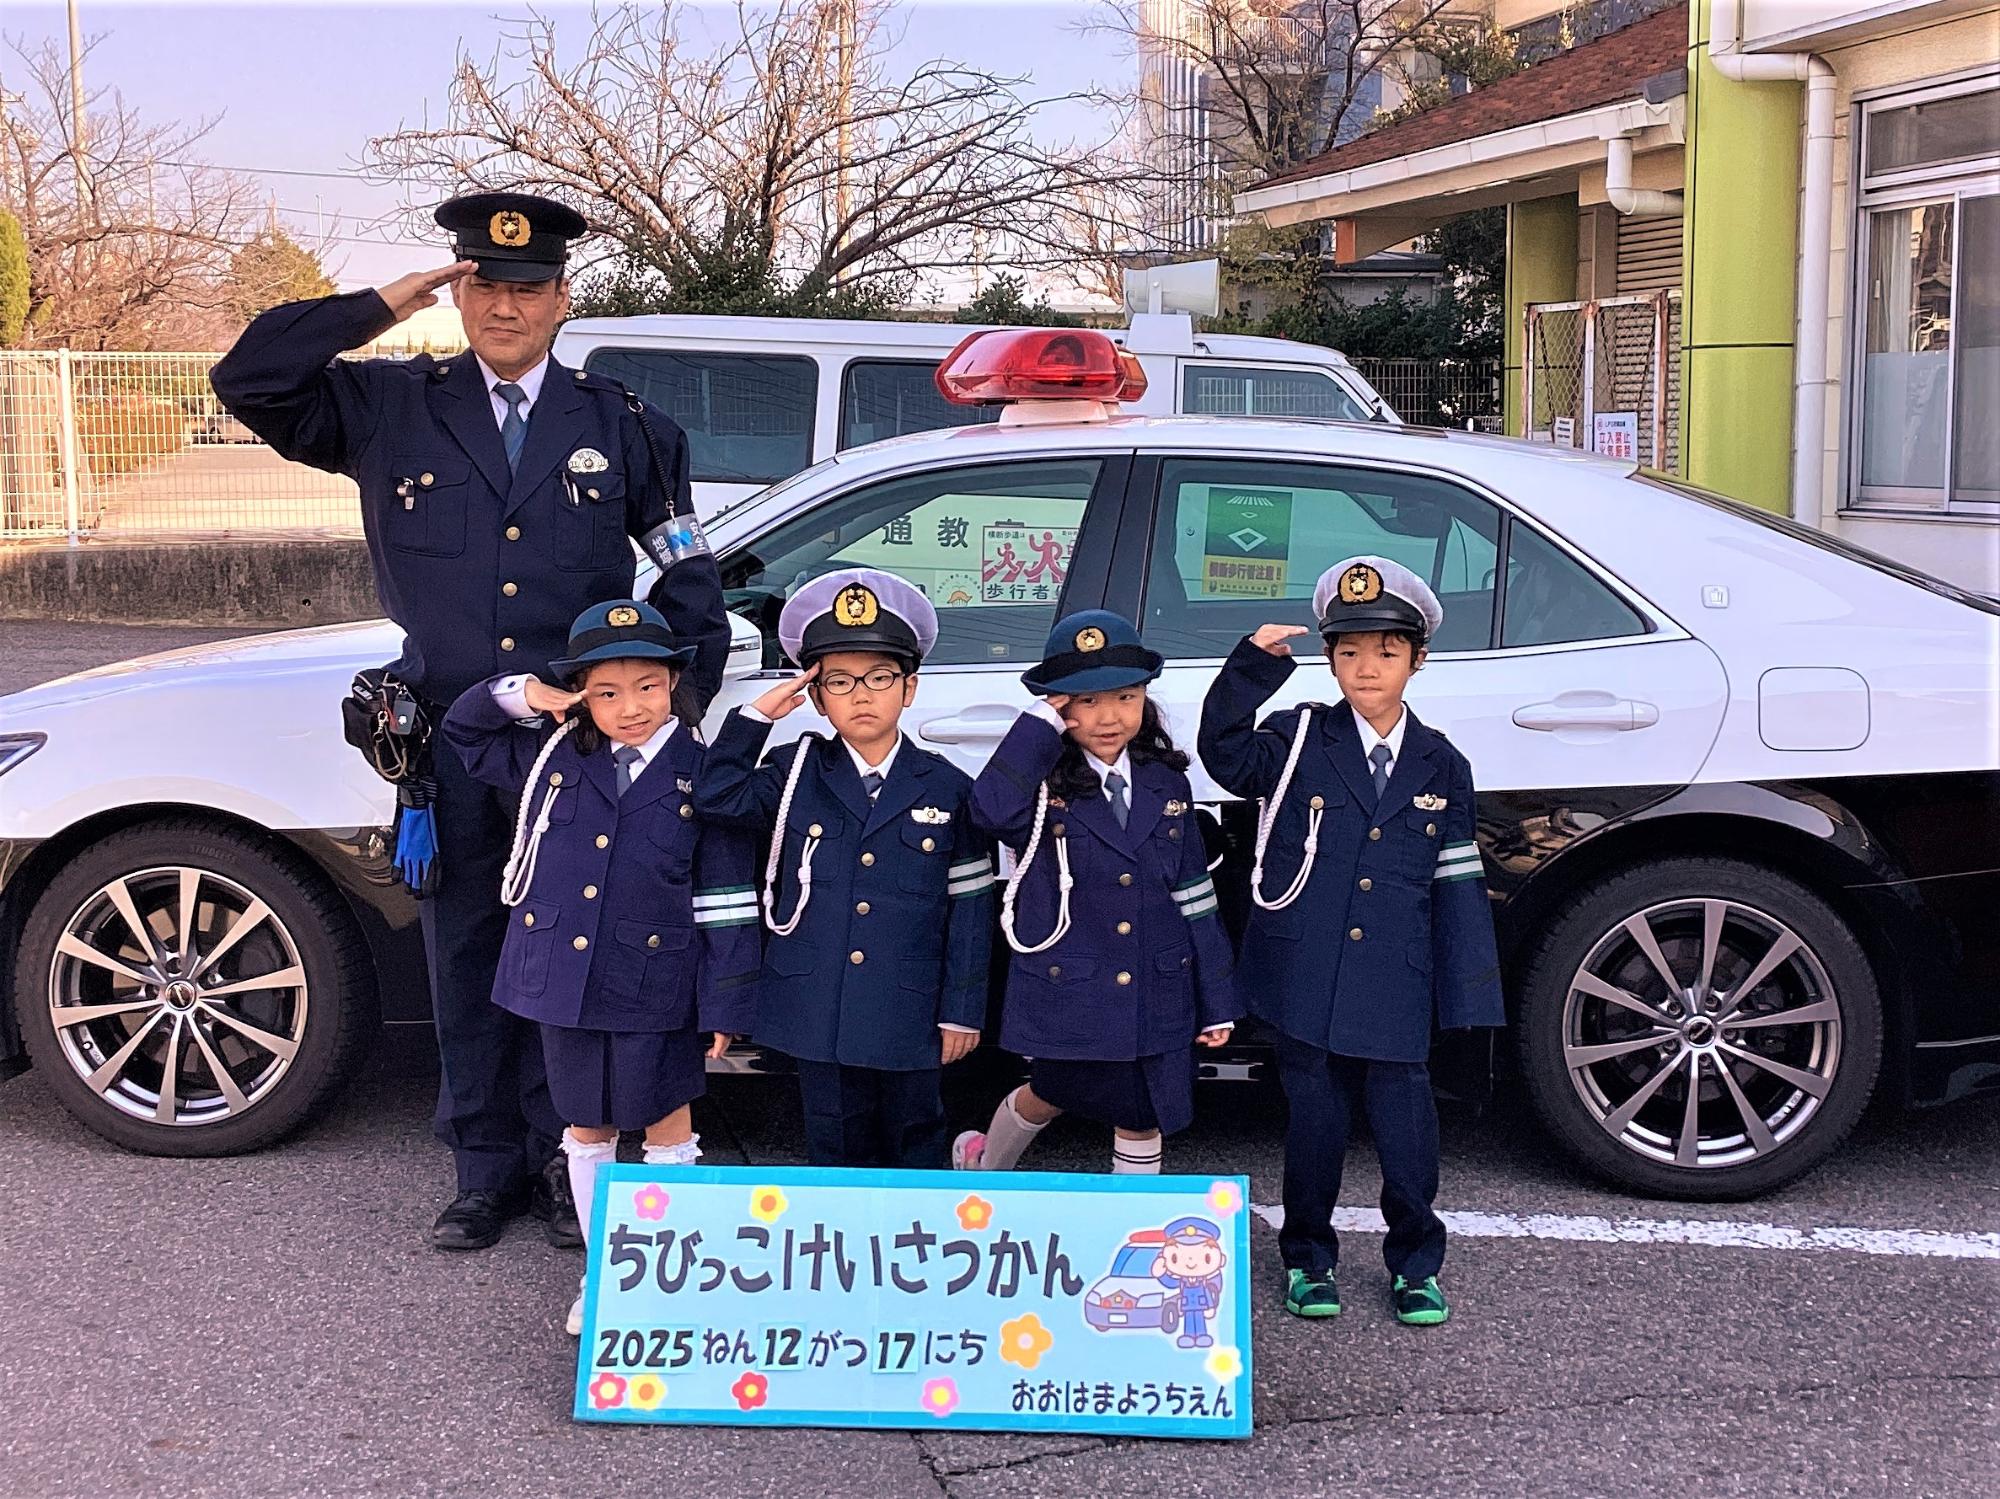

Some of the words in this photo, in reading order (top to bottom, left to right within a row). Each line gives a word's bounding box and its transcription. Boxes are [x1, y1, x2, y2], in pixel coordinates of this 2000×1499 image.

[1599, 431, 1631, 444] 立入禁止
[689, 521, 706, 551] 安全
[881, 515, 1025, 547] 通教
[652, 534, 674, 565] 地域
[986, 584, 1060, 600] 歩行者
[608, 1221, 1083, 1298] ちびっこけいさつかん
[1011, 1380, 1233, 1418] おおはまようちえん
